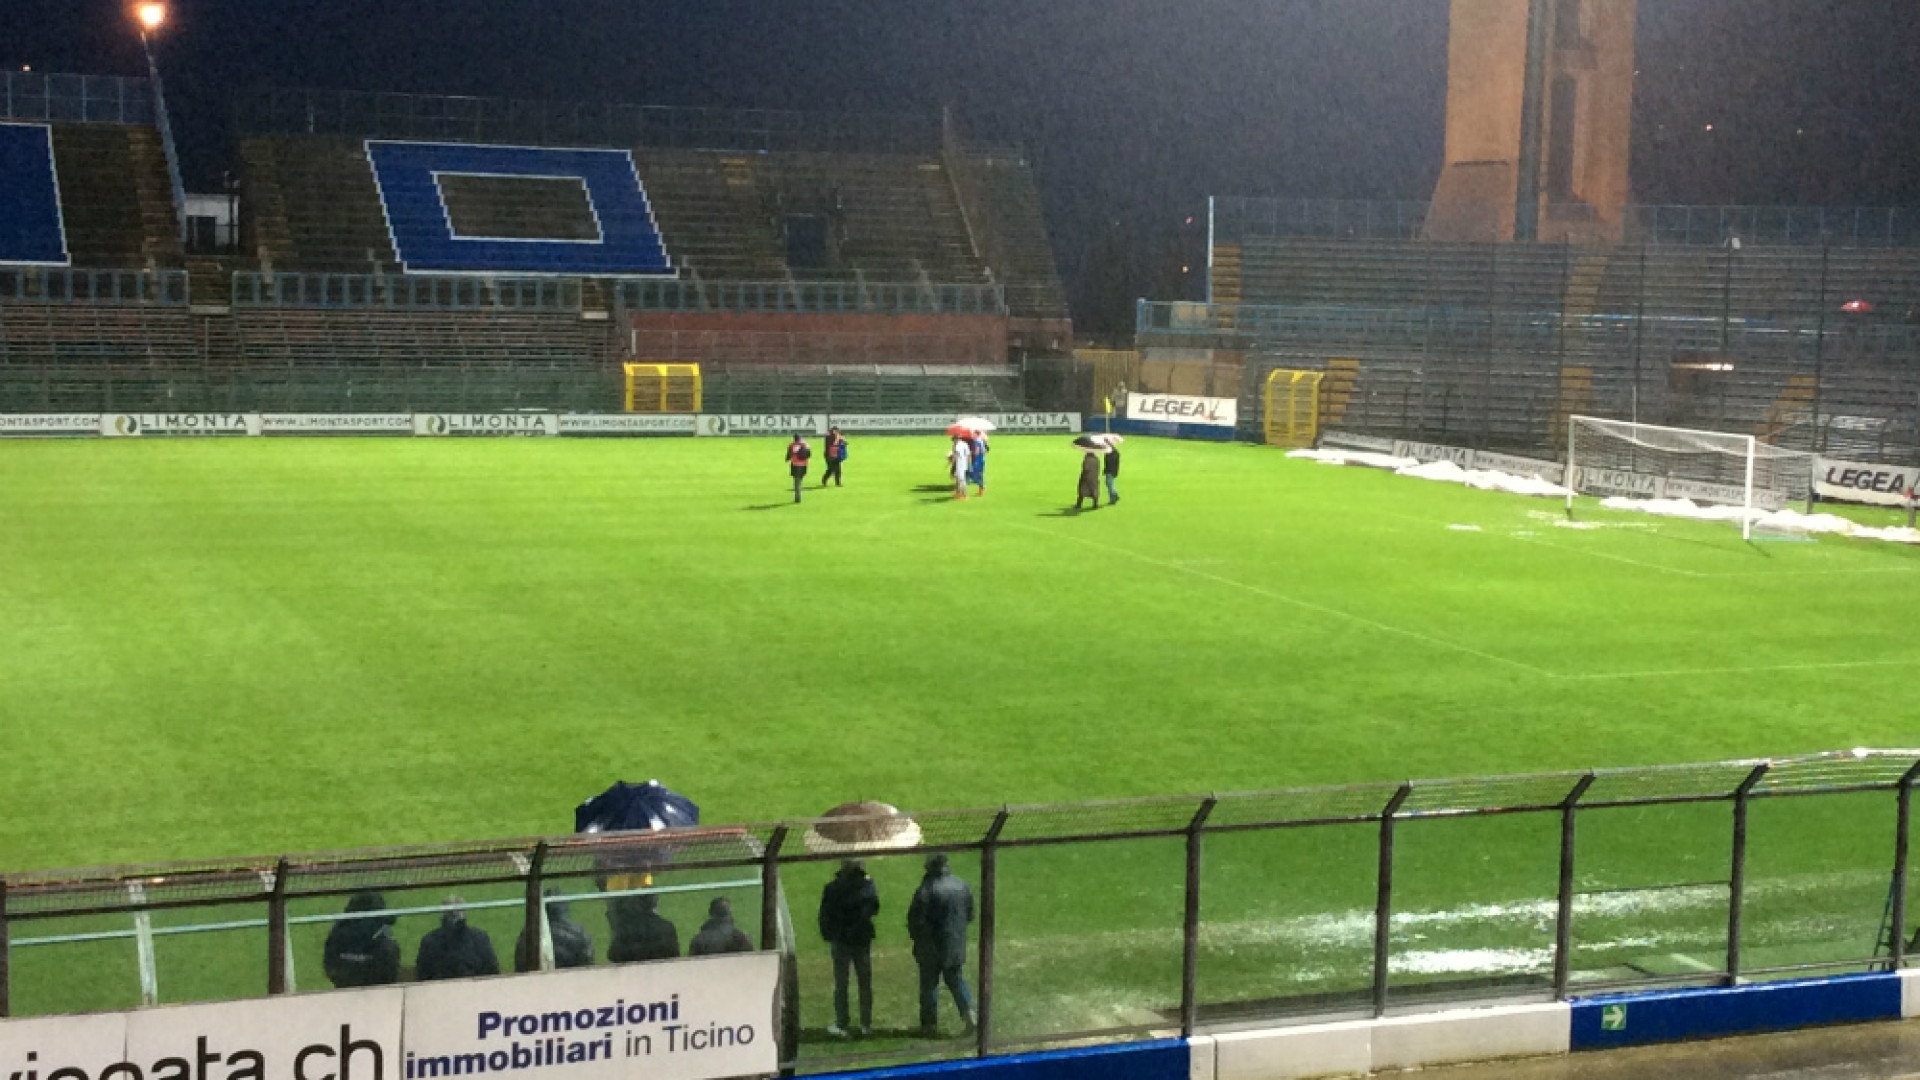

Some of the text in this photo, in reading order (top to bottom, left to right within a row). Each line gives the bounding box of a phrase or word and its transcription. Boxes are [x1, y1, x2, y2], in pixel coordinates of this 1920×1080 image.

[1139, 398, 1206, 416] LEGEA
[141, 414, 246, 427] LIMONTA
[449, 415, 545, 428] LIMONTA
[728, 415, 816, 428] LIMONTA
[1584, 468, 1656, 491] LIMONTA
[1826, 466, 1904, 493] LEGEA
[477, 993, 679, 1040] Promozioni
[406, 1021, 755, 1079] immobiliari in Ticino
